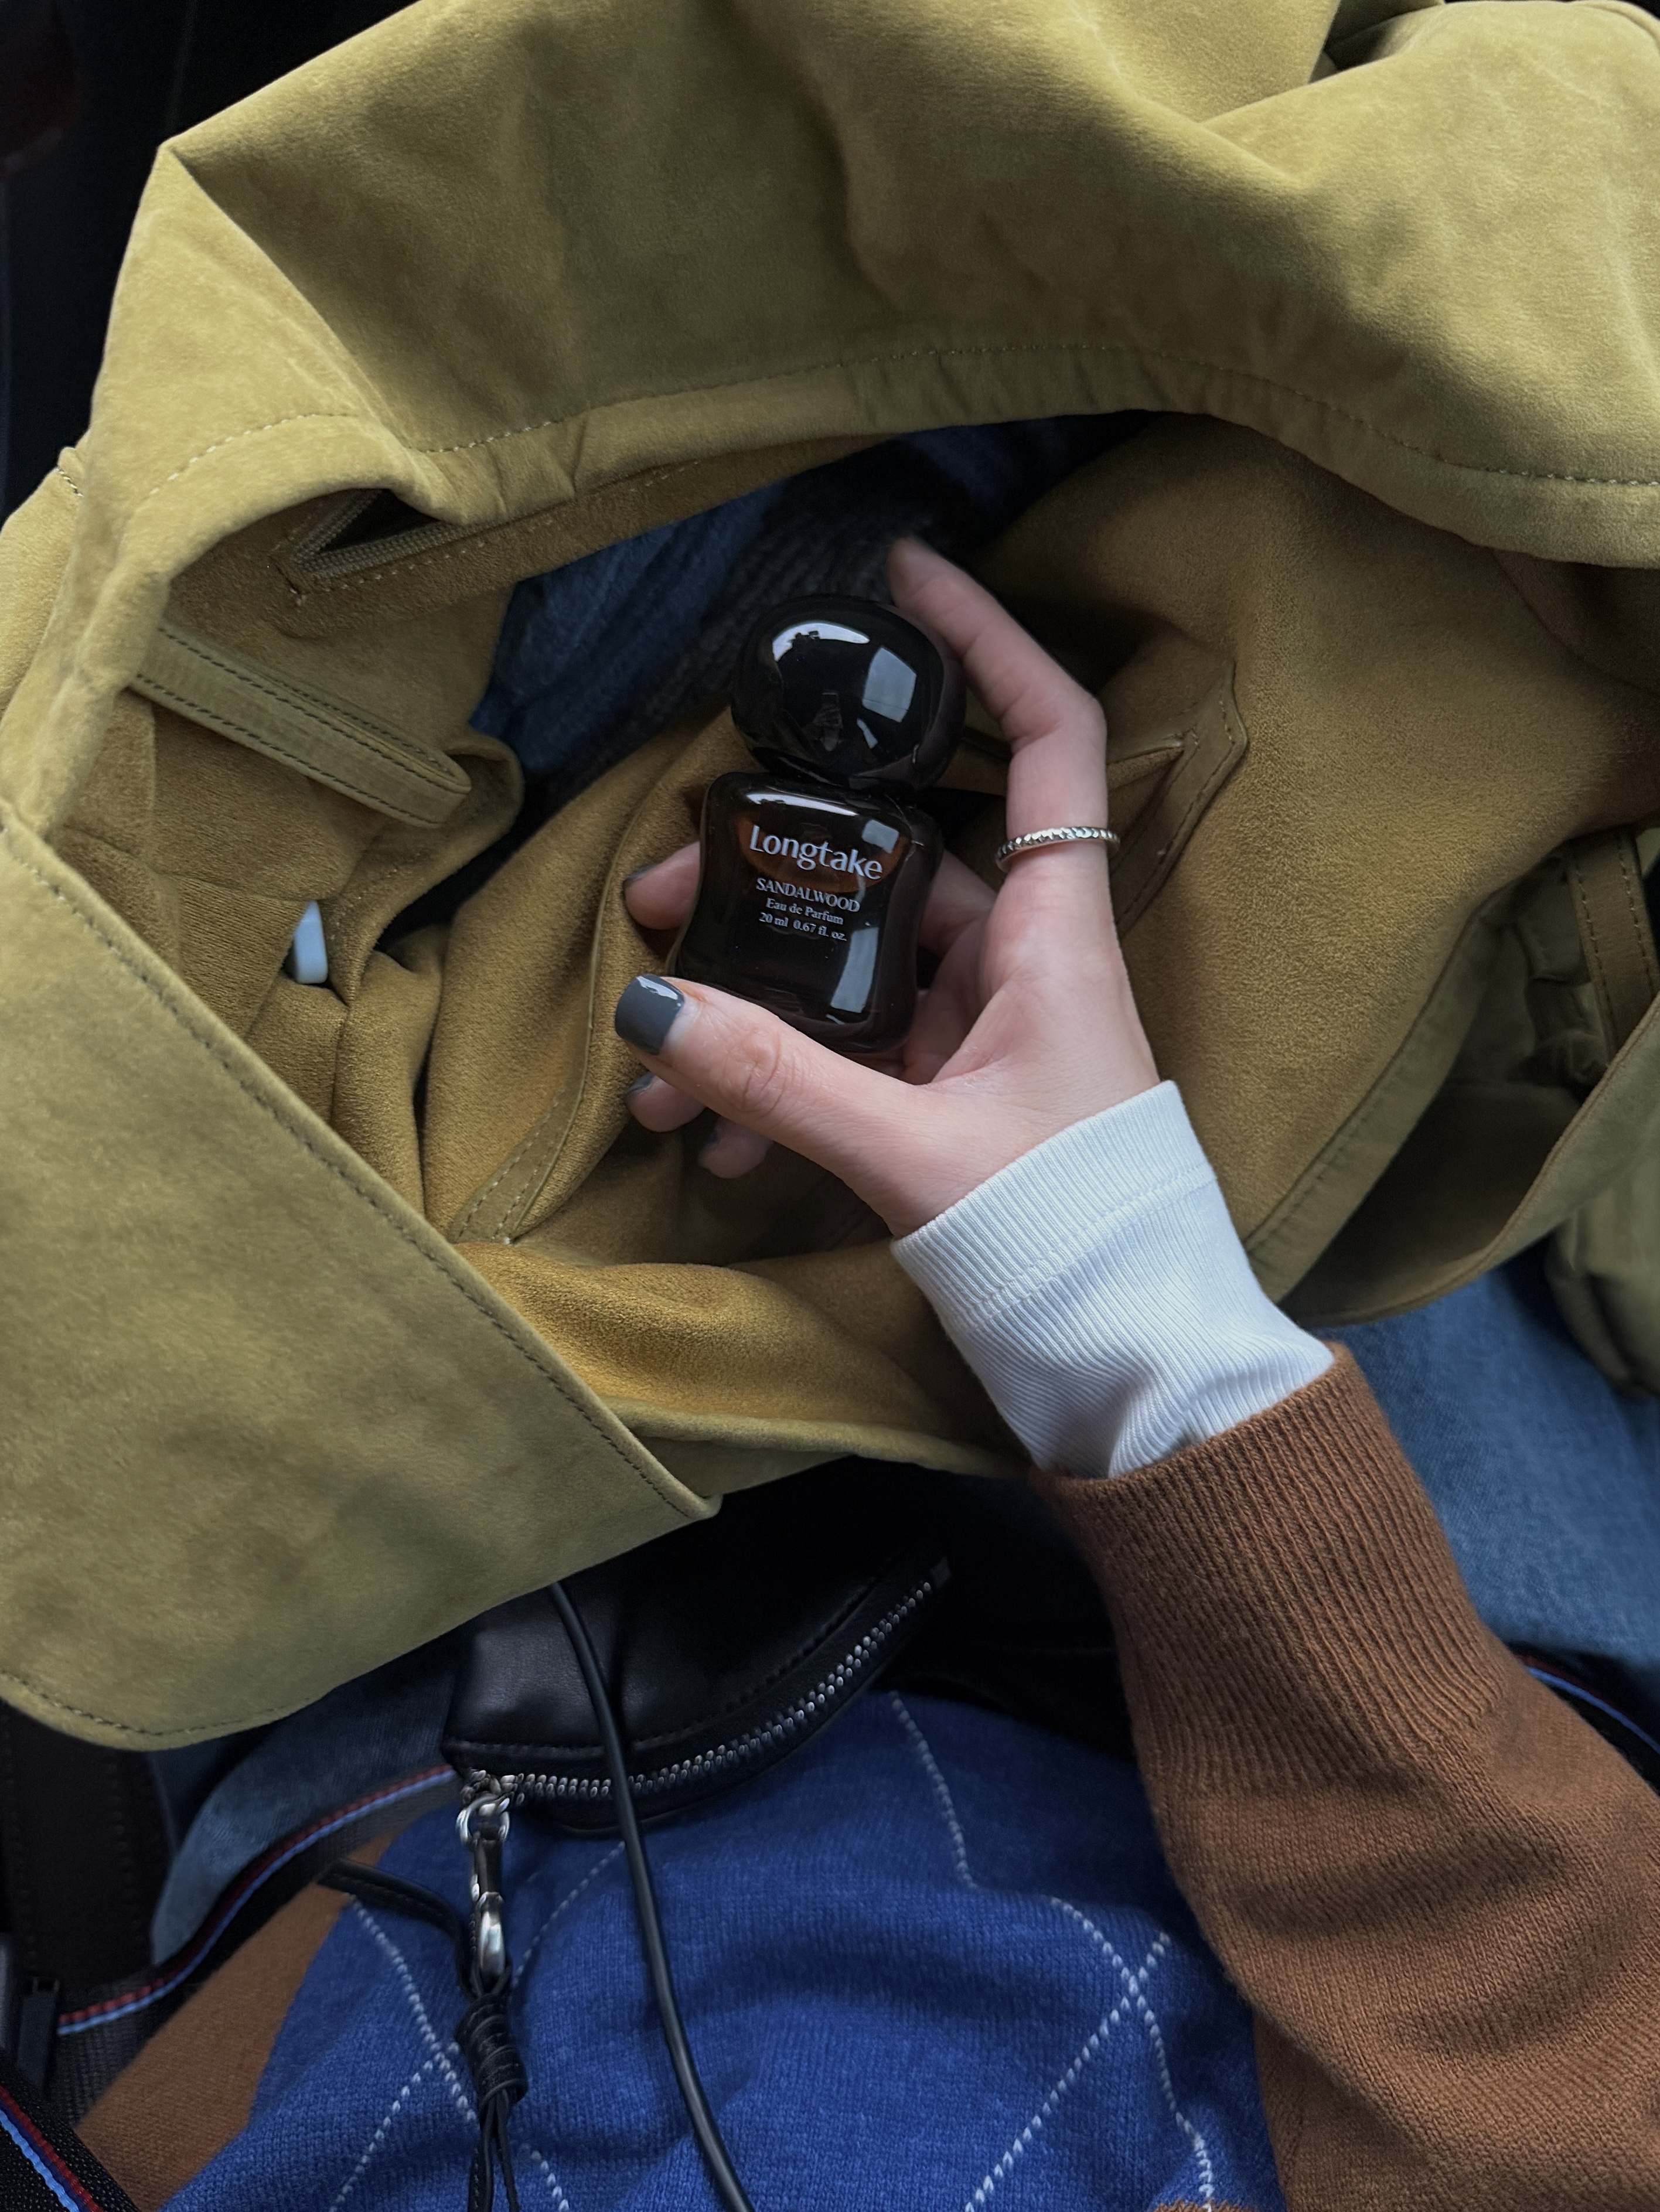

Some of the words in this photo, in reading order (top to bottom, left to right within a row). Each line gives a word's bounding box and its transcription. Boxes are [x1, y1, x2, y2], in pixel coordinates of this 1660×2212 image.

[750, 824, 883, 880] Longtake
[756, 877, 860, 912] SANDALWOOD
[759, 912, 772, 923] 20
[774, 916, 788, 927] ml
[793, 920, 816, 933] 0.67
[818, 925, 829, 937] fl.
[831, 931, 847, 941] oz.
[766, 897, 787, 912] Eau
[789, 903, 803, 915] de
[805, 906, 843, 925] Parfum
